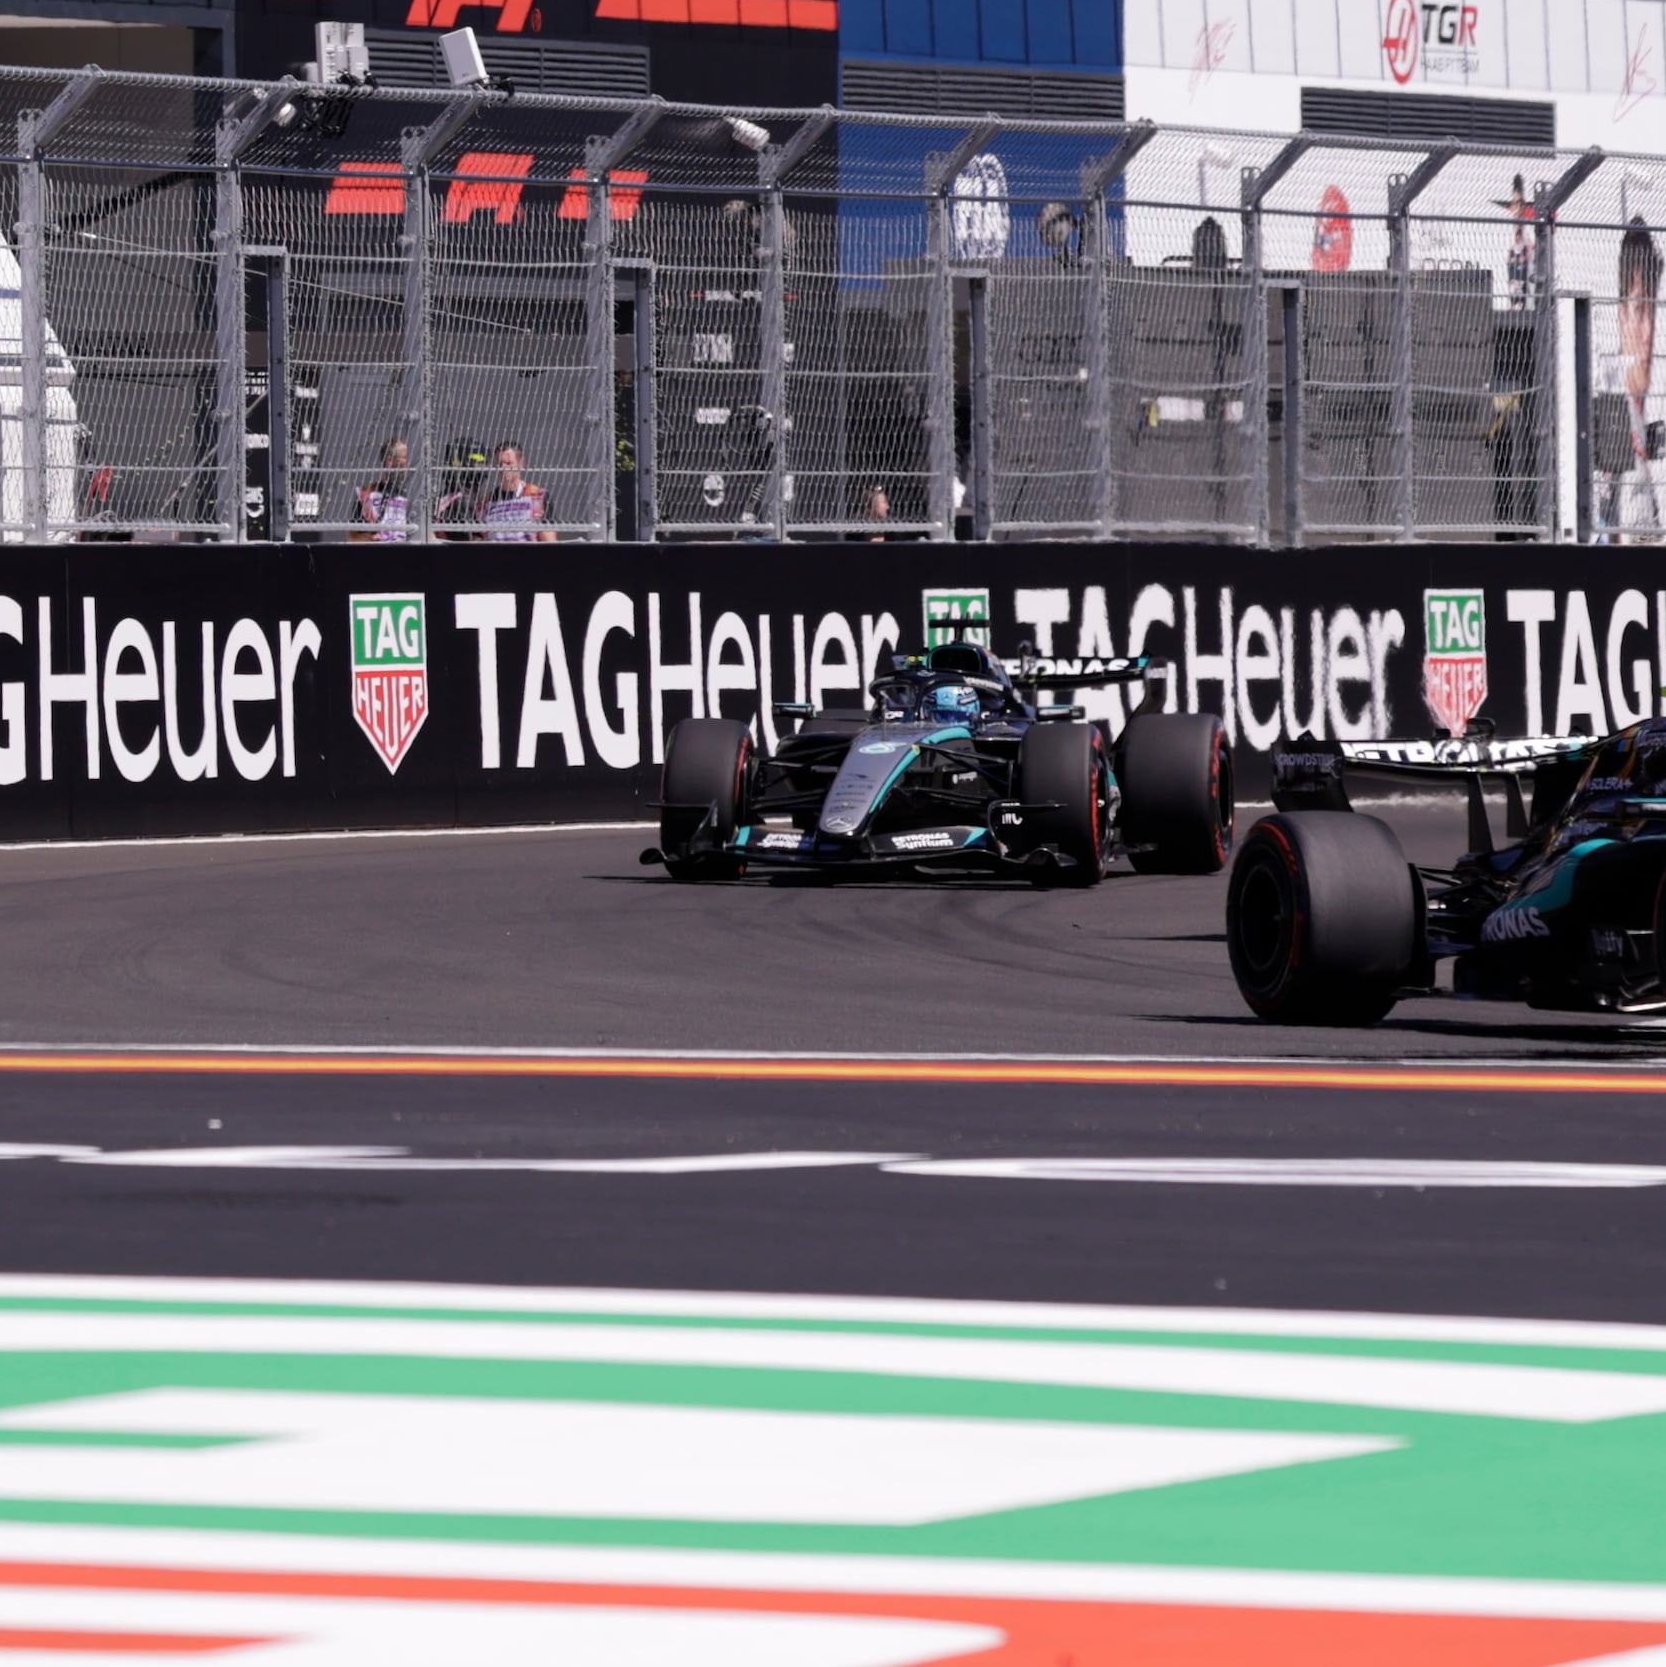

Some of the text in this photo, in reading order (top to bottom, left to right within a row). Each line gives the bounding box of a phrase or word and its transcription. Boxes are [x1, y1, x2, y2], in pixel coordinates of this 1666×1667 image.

[1422, 3, 1479, 47] TGR
[357, 605, 421, 659] TAG
[1429, 596, 1482, 647] TAG
[355, 675, 426, 761] HEUER
[1426, 663, 1487, 732] HEUER
[891, 831, 950, 843] PETRONAS
